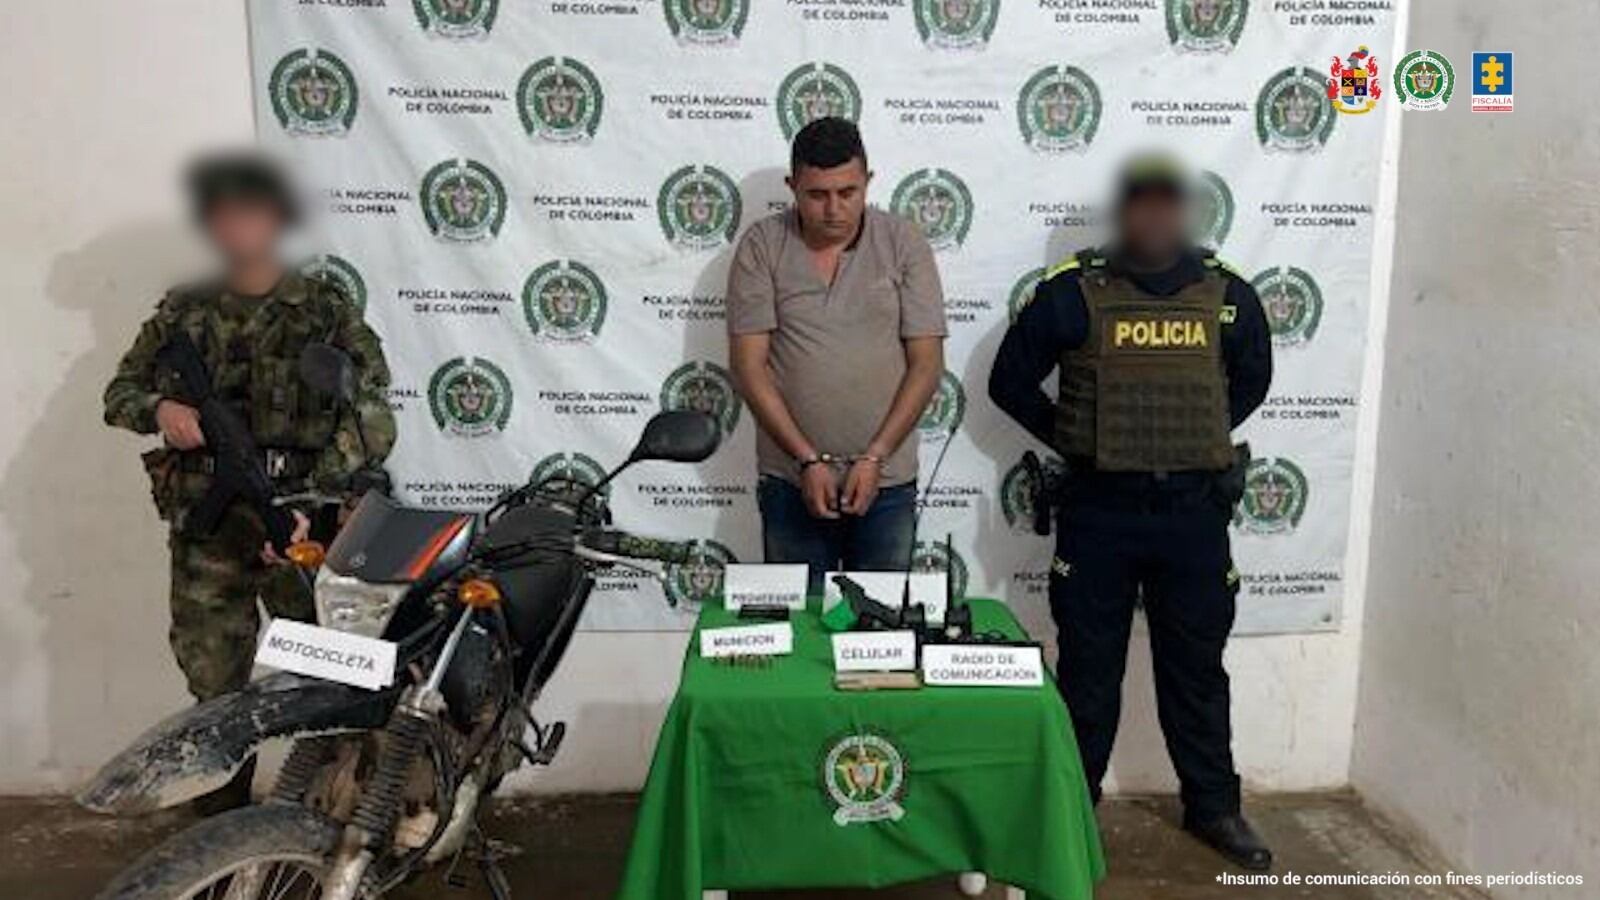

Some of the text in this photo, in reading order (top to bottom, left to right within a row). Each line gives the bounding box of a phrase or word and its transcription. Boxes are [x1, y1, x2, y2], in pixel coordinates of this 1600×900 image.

[552, 3, 639, 15] DE COLOMBIA
[1329, 1, 1392, 10] NACIONAL
[803, 9, 889, 20] DE COLOMBIA
[1055, 13, 1139, 23] DE COLOMBIA
[1290, 14, 1376, 25] DE COLOMBIA
[441, 89, 509, 100] NACIONAL
[703, 96, 768, 107] NACIONAL
[937, 100, 1000, 110] NACIONAL
[1183, 102, 1248, 112] NACIONAL
[406, 102, 492, 114] DE COLOMBIA
[667, 110, 753, 120] DE COLOMBIA
[901, 113, 984, 123] DE COLOMBIA
[1147, 115, 1232, 125] DE COLOMBIA
[585, 197, 650, 208] NACIONAL
[1311, 204, 1373, 214] NACIONAL
[549, 210, 634, 221] DE COLOMBIA
[1274, 217, 1357, 226] DE COLOMBIA
[451, 291, 514, 302] NACIONAL
[413, 303, 498, 314] DE COLOMBIA
[659, 309, 674, 319] DE
[1115, 321, 1206, 347] POLICIA
[590, 391, 652, 402] NACIONAL
[1298, 397, 1356, 406] NACIONAL
[554, 405, 638, 415] DE COLOMBIA
[1262, 410, 1340, 420] DE COLOMBIA
[687, 486, 749, 496] NACIONAL
[421, 496, 437, 505] DE
[653, 497, 733, 507] DE COLOMBIA
[1284, 572, 1341, 583] NACIONAL
[1249, 585, 1325, 596] DE COLOMBIA
[268, 635, 376, 672] MOTOCICLETA
[841, 648, 903, 661] CELULAR
[951, 653, 1016, 665] RADIO DE
